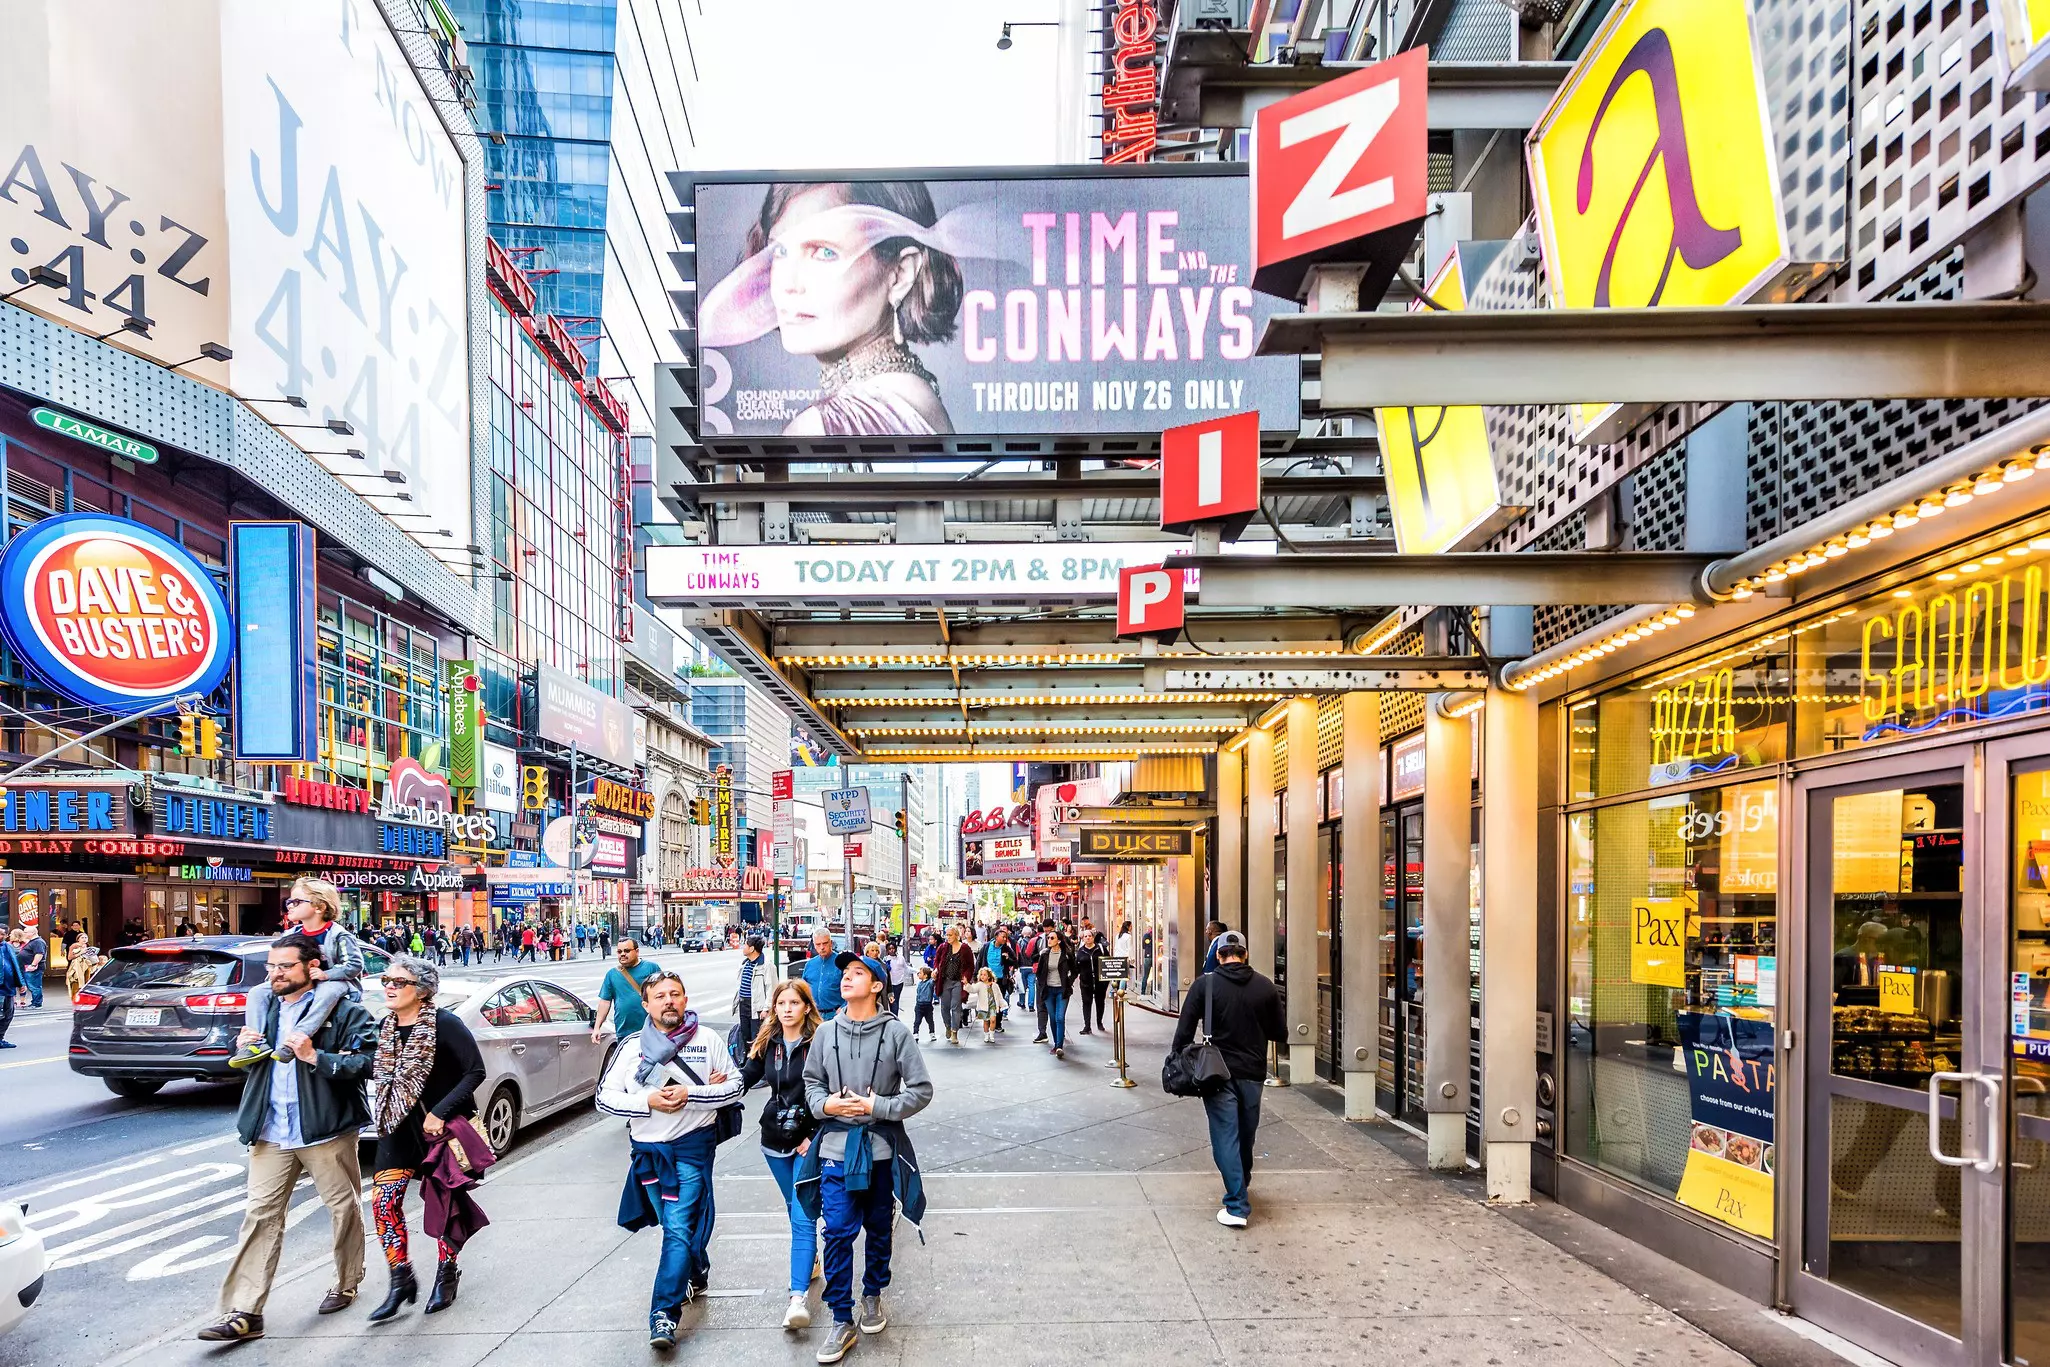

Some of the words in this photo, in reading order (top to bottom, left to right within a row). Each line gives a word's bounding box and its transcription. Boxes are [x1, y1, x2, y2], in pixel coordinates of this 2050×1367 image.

[373, 40, 455, 211] NOW
[1279, 77, 1400, 240] Z
[1022, 210, 1179, 286] TIME
[1178, 251, 1208, 270] AND
[1209, 264, 1238, 284] THE
[963, 285, 1254, 362] CONWAYS
[736, 390, 821, 401] ROUNDABOUT
[736, 400, 785, 411] THEATRE
[972, 382, 1079, 412] THROUGH
[1093, 381, 1138, 412] NOV
[1143, 380, 1172, 411] 26
[1184, 380, 1244, 411] ONLY
[736, 409, 799, 420] COMPANY
[53, 415, 142, 457] LAMAR
[1198, 430, 1222, 507] I
[702, 553, 741, 569] TIME
[794, 559, 896, 583] TODAY
[905, 560, 941, 582] AT
[951, 558, 1017, 582] 2PM
[1026, 557, 1050, 581] &
[1061, 557, 1124, 581] 8PM
[48, 565, 165, 614] DAVE
[160, 573, 199, 616] &
[687, 572, 760, 590] CONWAYS
[1129, 570, 1171, 625] P
[56, 617, 205, 660] BUSTER'S
[450, 664, 470, 736] Applebee's
[547, 681, 597, 721] MUMMIES
[1652, 668, 1735, 765] PIZZA
[285, 775, 371, 814] LIBERTY
[485, 777, 512, 797] Hilton
[595, 776, 656, 820] MODELL'S
[831, 789, 859, 801] NYPD
[165, 794, 271, 840] DINER
[381, 779, 496, 842] Applebee's
[718, 779, 730, 853] EMPIRE
[828, 808, 867, 820] SECURITY
[2020, 800, 2050, 817] Pax
[831, 817, 867, 828] CAMERA
[20, 840, 73, 854] PLAY
[84, 840, 186, 857] COMBO!!
[383, 824, 444, 857] DINER
[995, 839, 1022, 848] BEATLES
[1092, 835, 1171, 850] DUKE
[276, 851, 307, 864] DAVE
[311, 854, 334, 866] AND
[338, 856, 383, 869] BUSTER'S
[388, 859, 414, 871] "EAT"
[995, 849, 1021, 859] BRUNCH
[181, 864, 202, 880] EAT
[205, 865, 234, 881] DRINK
[235, 867, 252, 881] PLAY
[319, 870, 406, 888] Applebee's
[511, 887, 536, 897] EXCHANGE
[1634, 907, 1680, 947] Pax
[1883, 976, 1911, 996] Pax
[2029, 1043, 2050, 1057] PU
[1700, 1094, 1719, 1106] choose
[1719, 1098, 1733, 1108] from
[1733, 1102, 1743, 1111] our
[1744, 1105, 1762, 1116] chef's
[1715, 1187, 1747, 1218] Pax
